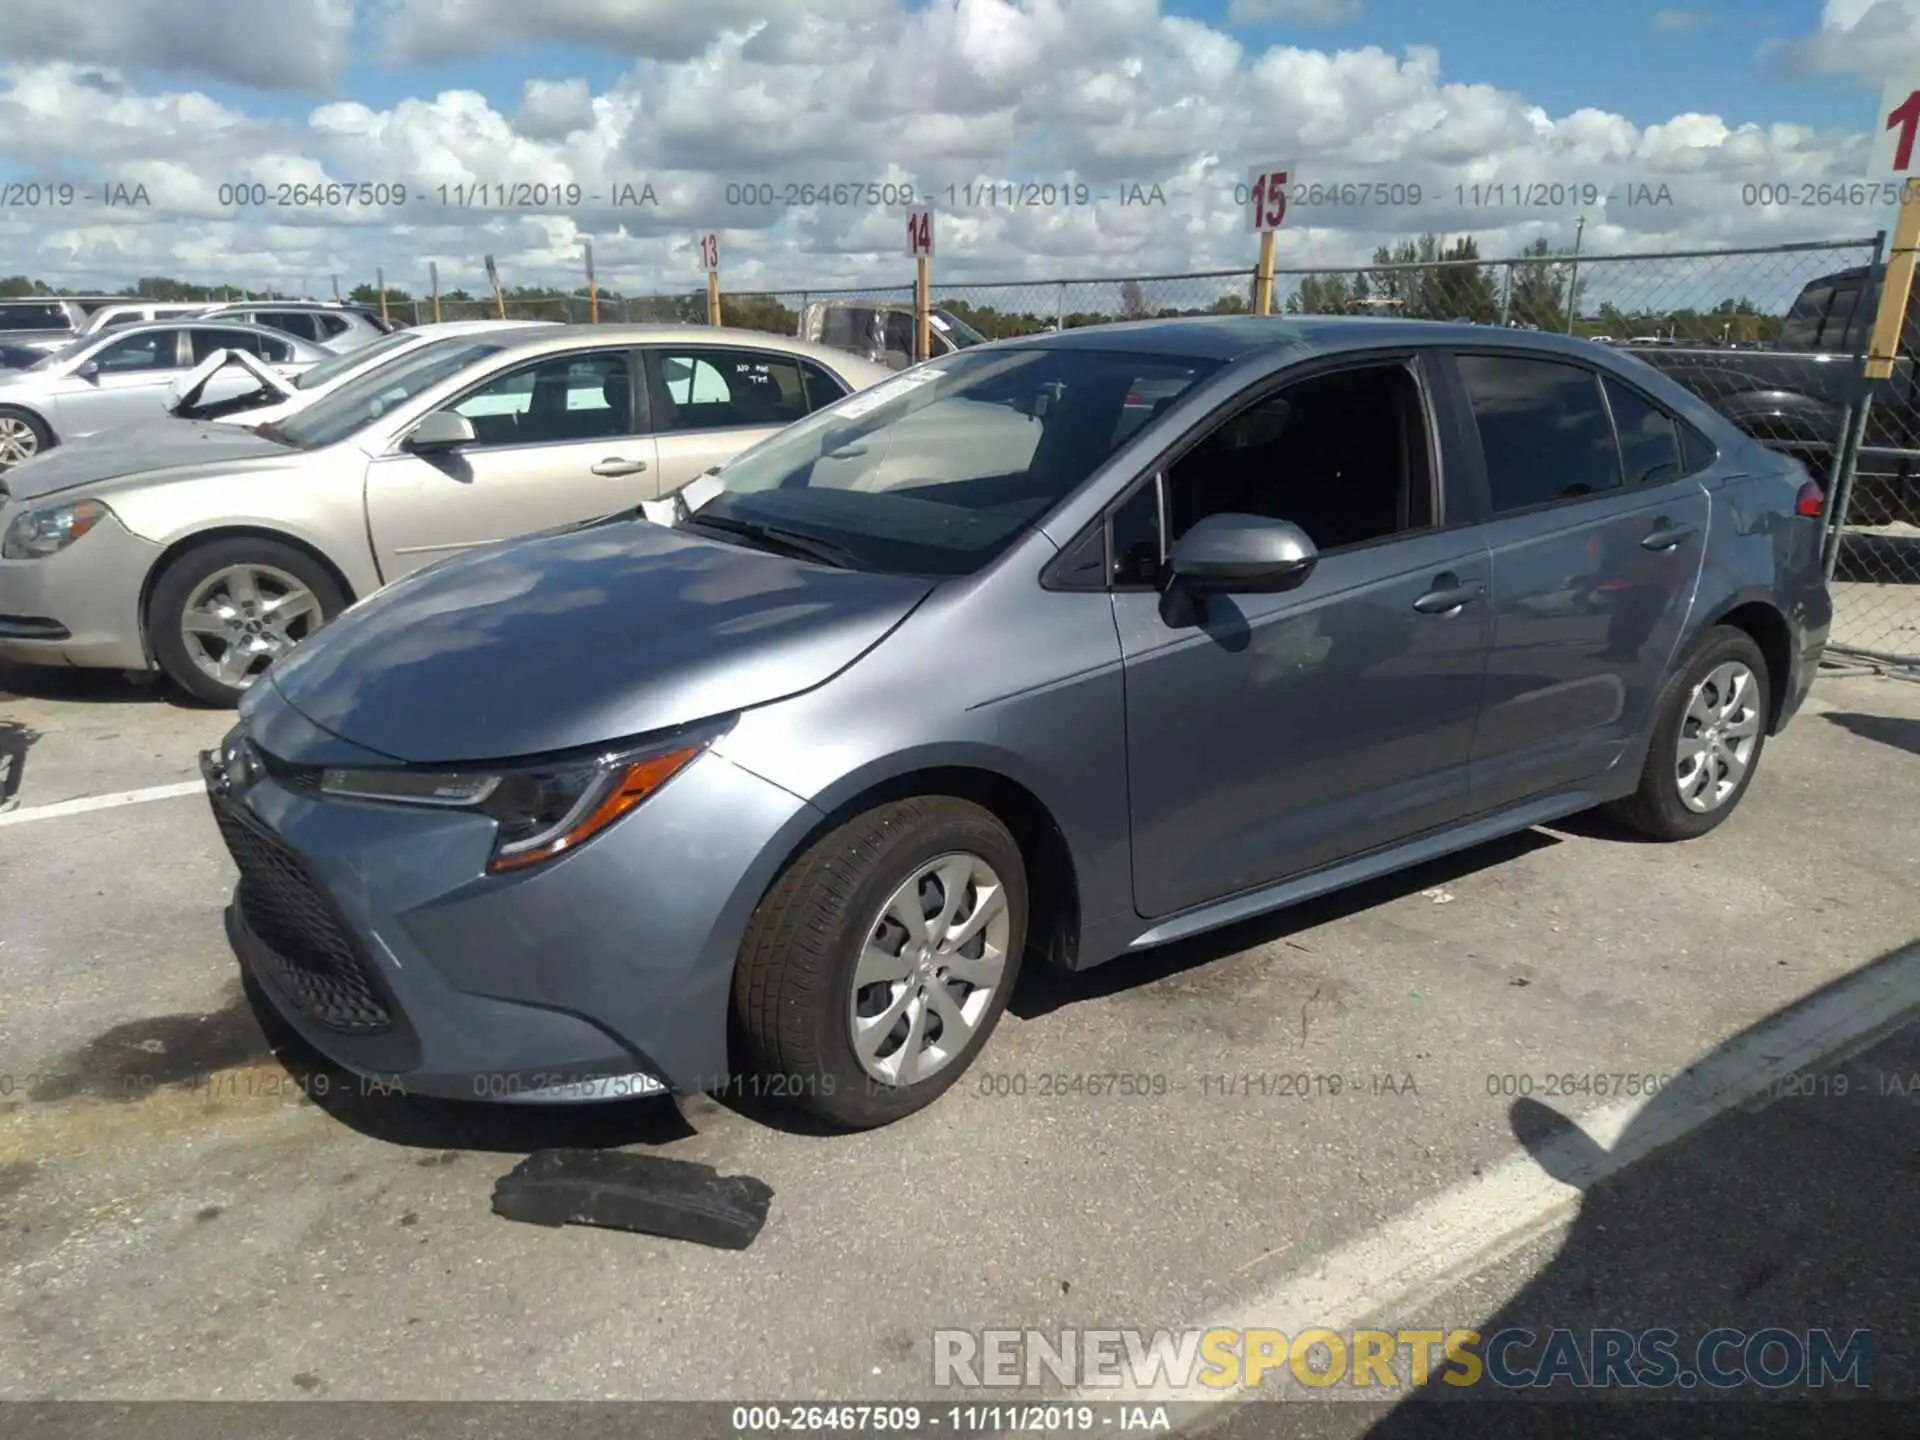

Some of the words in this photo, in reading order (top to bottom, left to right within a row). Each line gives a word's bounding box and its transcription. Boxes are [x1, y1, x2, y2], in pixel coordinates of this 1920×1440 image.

[1251, 171, 1288, 229] 15
[700, 234, 718, 268] 13
[908, 212, 931, 254] 14
